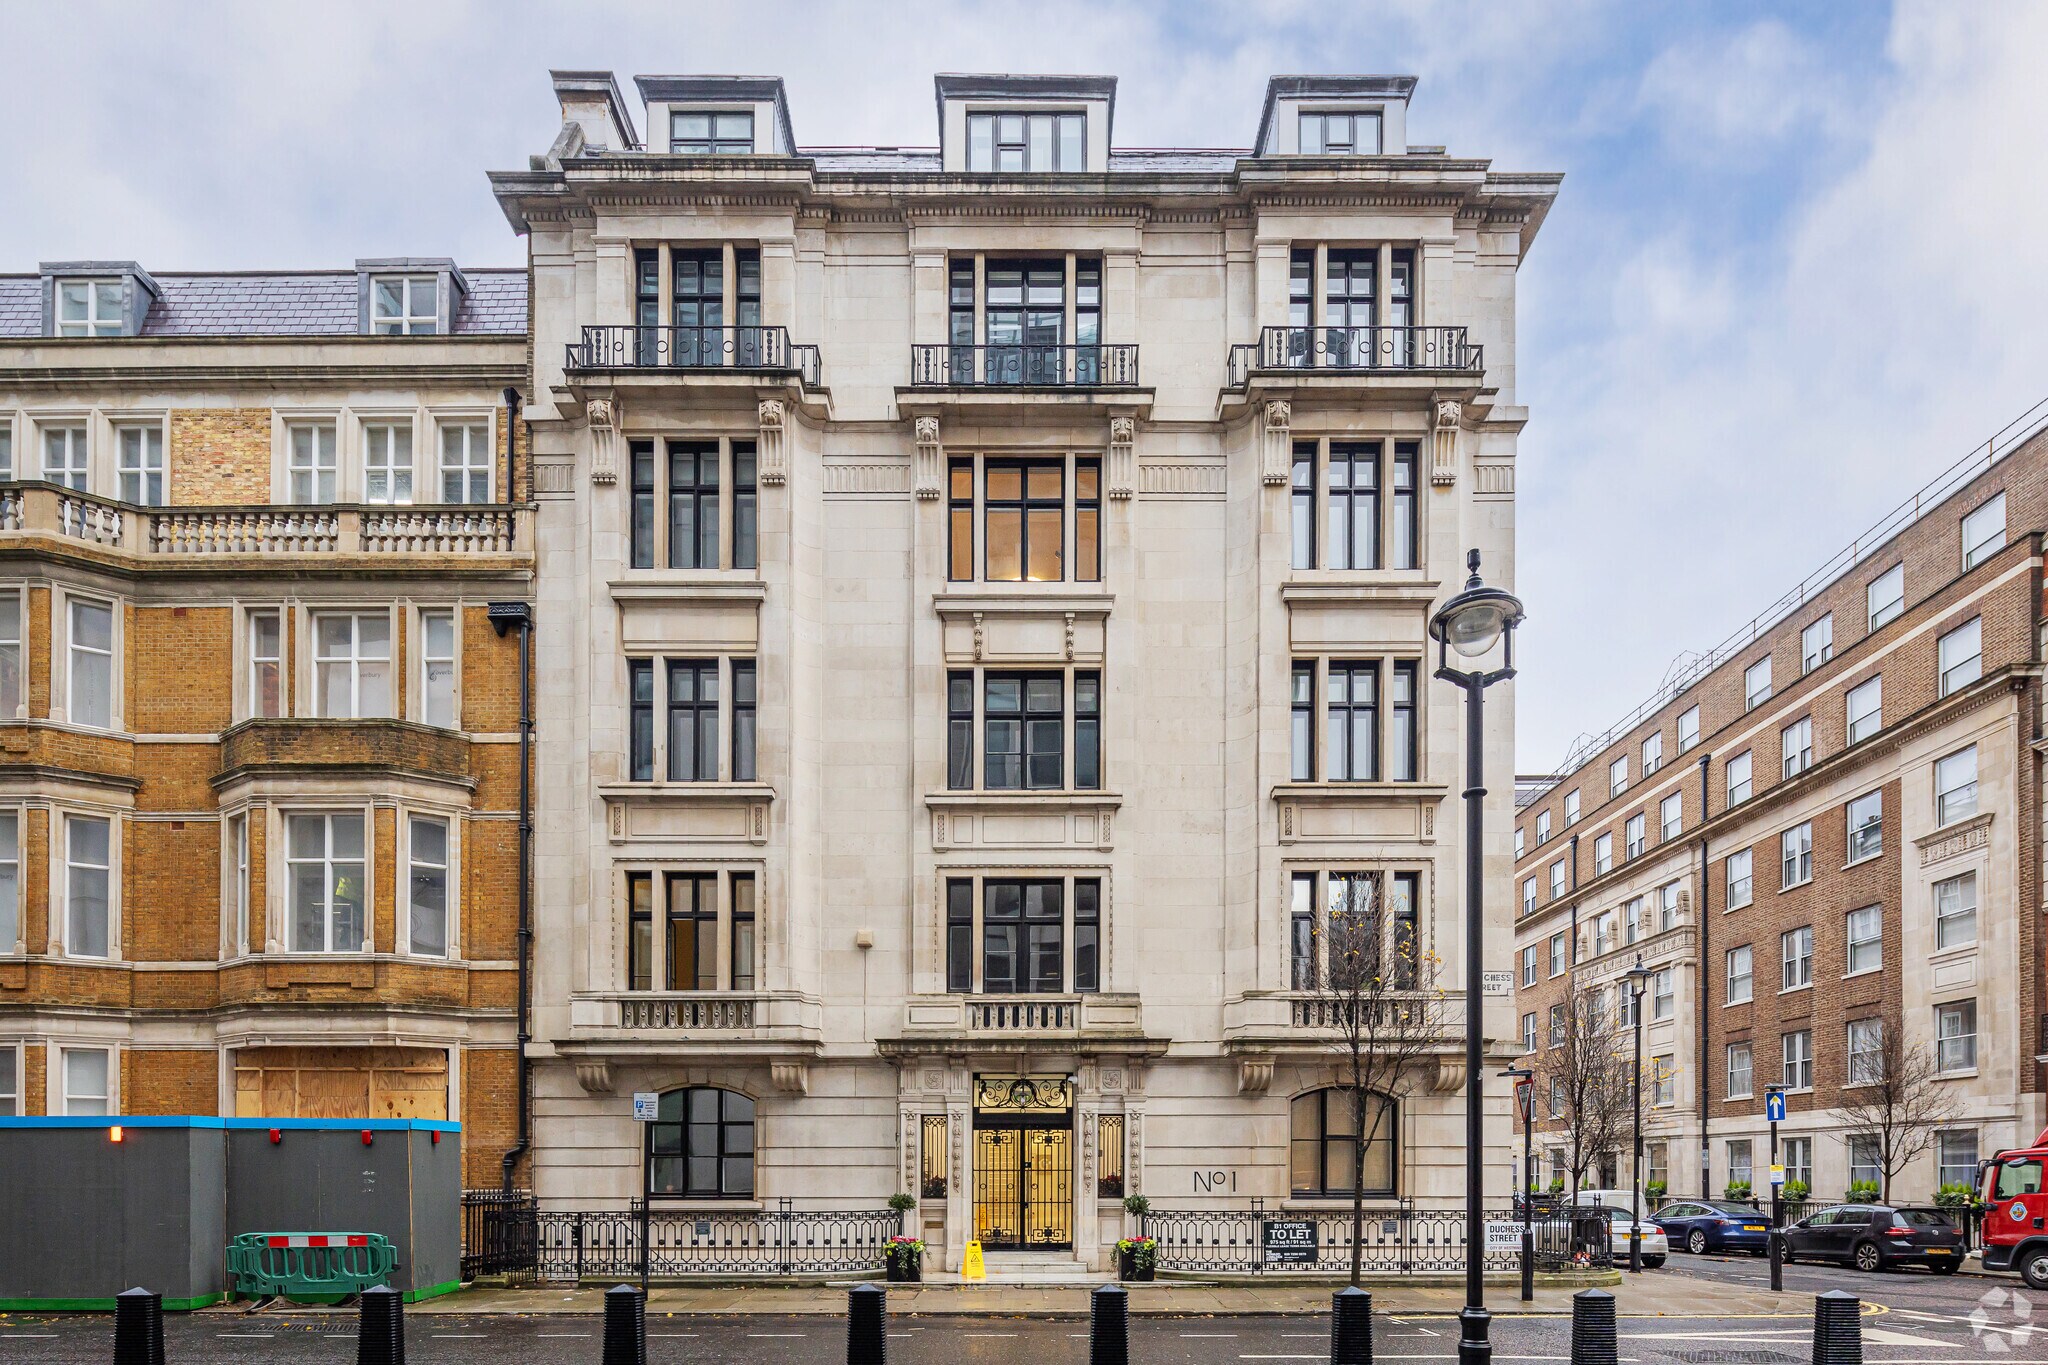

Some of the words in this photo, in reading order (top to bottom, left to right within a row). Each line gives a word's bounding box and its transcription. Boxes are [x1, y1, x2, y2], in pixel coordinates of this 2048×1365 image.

[1490, 1225, 1524, 1233] DUCHESS
[1270, 1229, 1287, 1239] TO
[1289, 1229, 1311, 1239] LET
[1490, 1234, 1518, 1242] STREET
